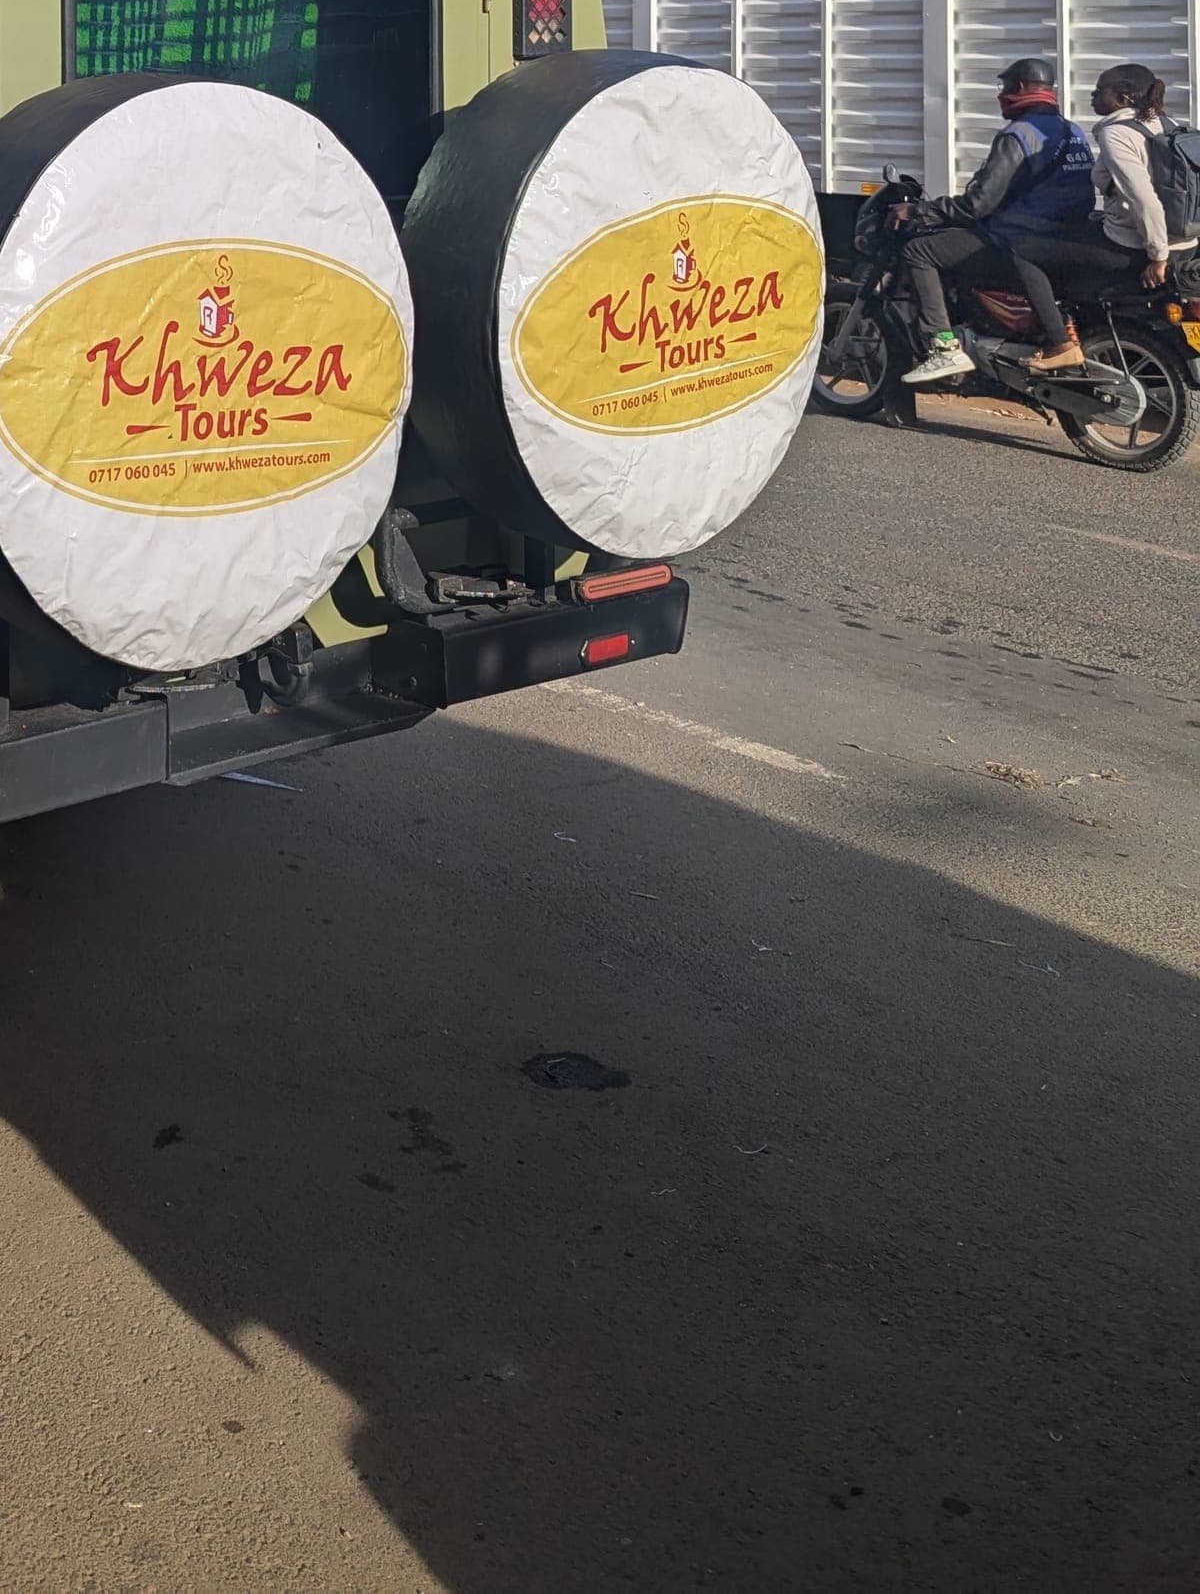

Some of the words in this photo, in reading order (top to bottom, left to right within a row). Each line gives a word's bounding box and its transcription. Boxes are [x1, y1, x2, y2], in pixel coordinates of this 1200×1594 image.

[588, 271, 784, 353] Khweza
[87, 320, 352, 406] Khweza
[655, 334, 726, 373] Tours
[592, 400, 618, 416] 0717
[620, 395, 640, 411] 060
[641, 390, 659, 406] 045
[670, 362, 773, 397] www.khwezatours.com
[174, 403, 269, 442] Tours
[88, 467, 120, 483] 0717
[124, 465, 150, 480] 060
[152, 462, 176, 478] 045
[192, 451, 331, 474] www.khwezatours.com
